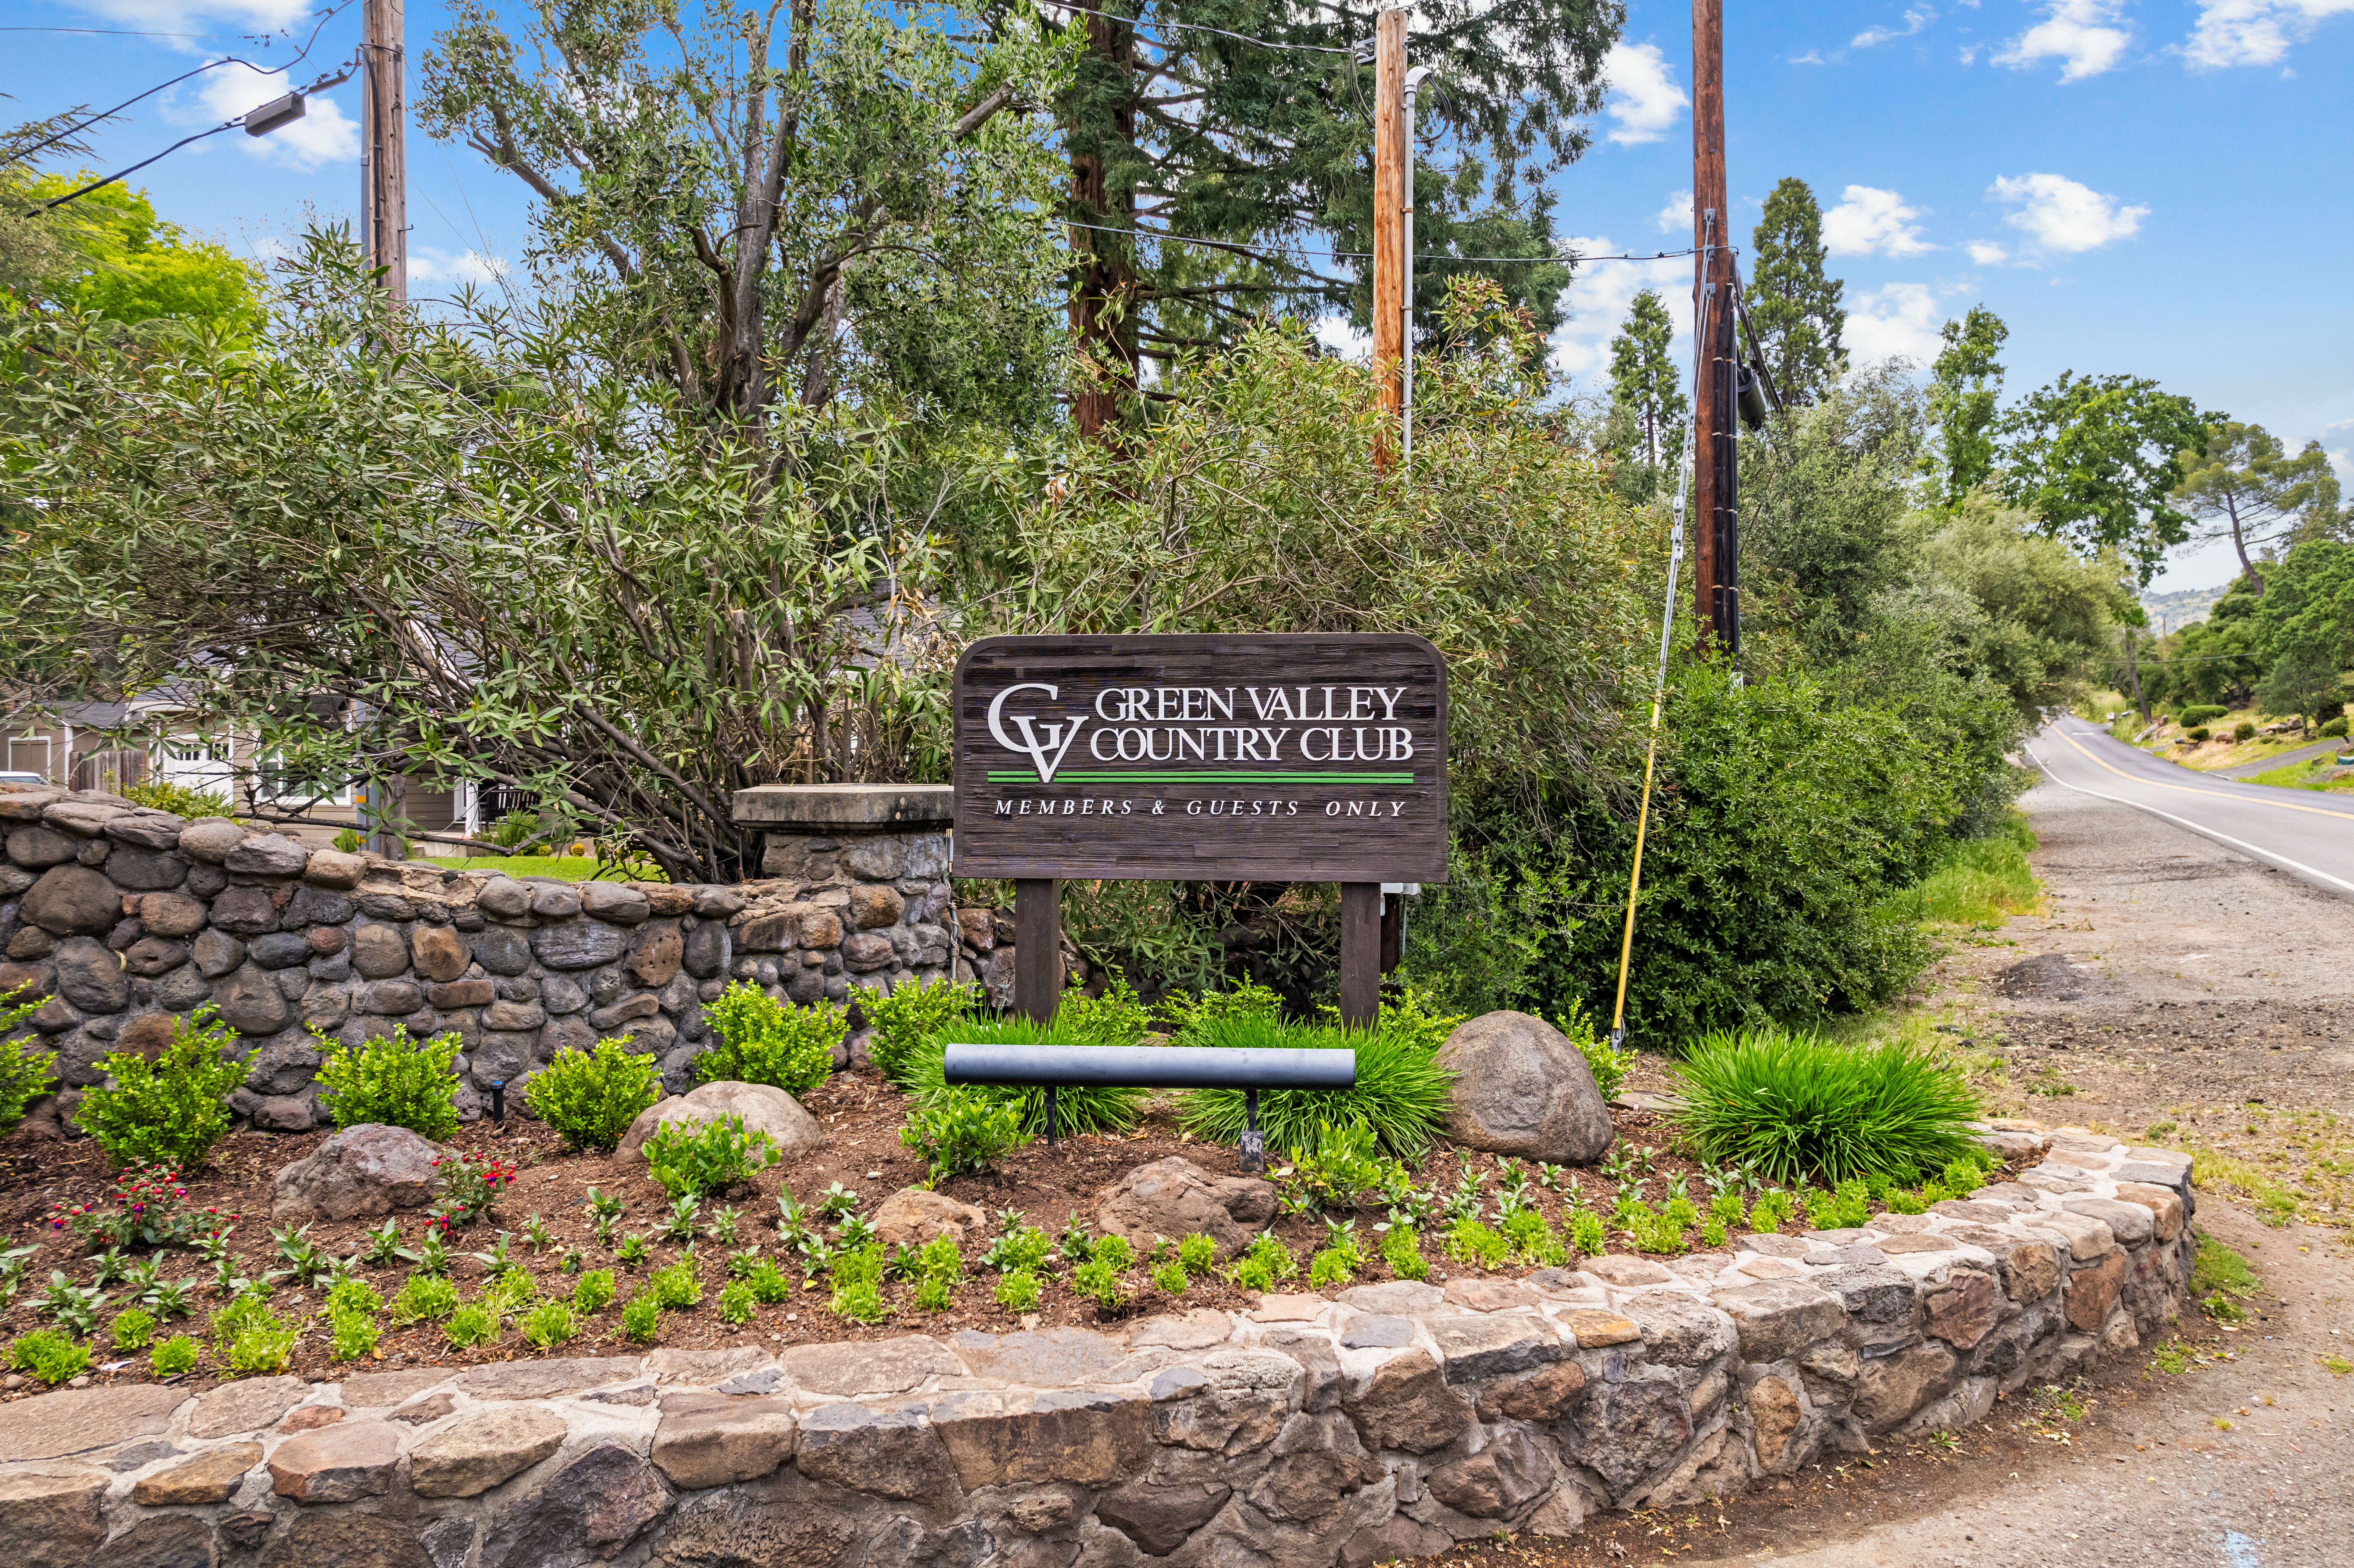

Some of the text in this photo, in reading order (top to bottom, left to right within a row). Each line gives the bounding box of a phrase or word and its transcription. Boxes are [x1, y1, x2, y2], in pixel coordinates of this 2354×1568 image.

[1095, 687, 1407, 721] GREEN VALLEY
[1090, 727, 1414, 761] COUNTRY CLUB
[994, 800, 1407, 817] MEMBERS & GUESTS ONLY
